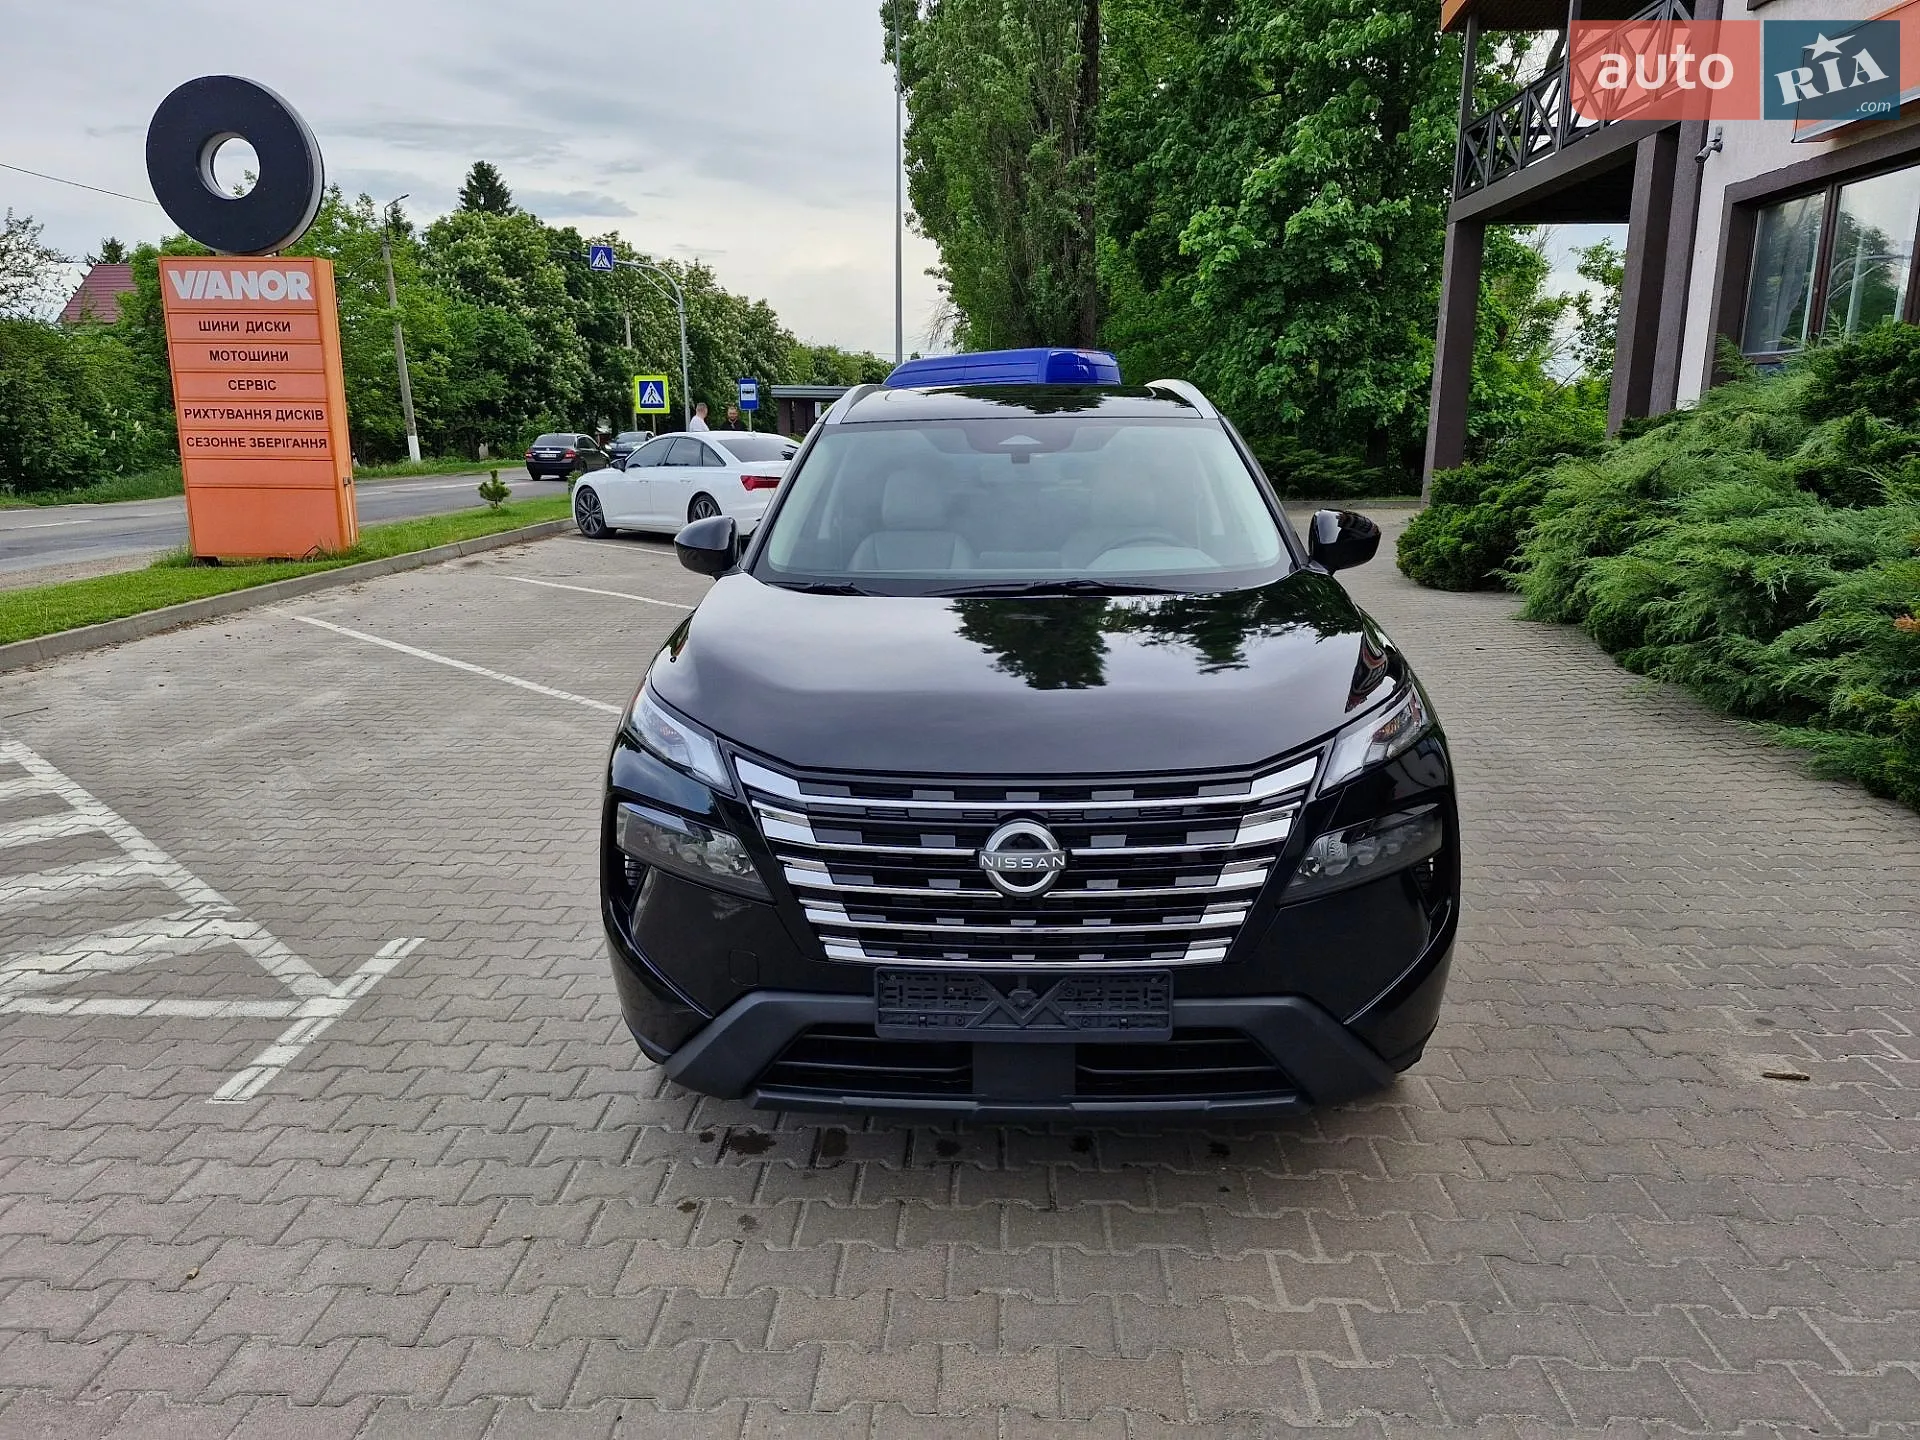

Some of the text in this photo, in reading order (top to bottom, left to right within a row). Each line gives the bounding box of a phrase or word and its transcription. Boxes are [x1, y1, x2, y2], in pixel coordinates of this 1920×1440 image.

[167, 269, 313, 301] VIANOR
[199, 320, 291, 333] ШИНИ ДИСКИ
[209, 350, 289, 362] МОТОШИНИ
[228, 379, 277, 391] СЕРВІС
[184, 408, 324, 422] РИХТУВАННЯ ДИСКІВ
[186, 437, 327, 449] СЕЗОННЕ ЗБЕРІГАННЯ
[981, 854, 1065, 869] NISSAN
